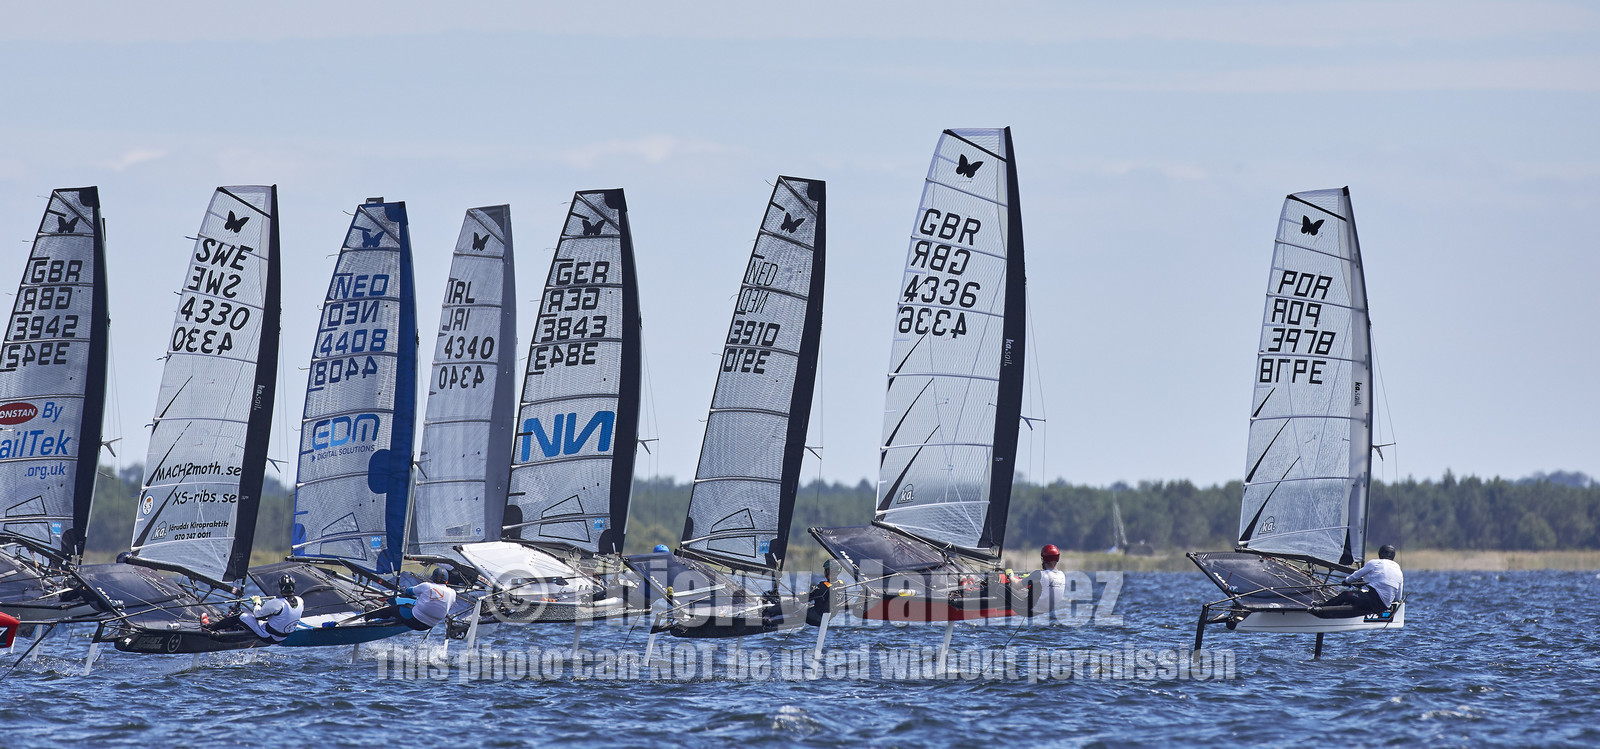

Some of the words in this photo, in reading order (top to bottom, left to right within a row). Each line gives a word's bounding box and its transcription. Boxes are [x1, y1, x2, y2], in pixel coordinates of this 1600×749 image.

[920, 208, 982, 246] GBR
[196, 238, 254, 271] SWE
[31, 260, 82, 283] GBR
[556, 261, 610, 285] GER
[746, 260, 778, 286] NED
[334, 274, 389, 299] NED
[447, 280, 475, 304] IRL
[904, 275, 980, 308] 4336
[1278, 270, 1332, 300] POR
[180, 296, 250, 331] 4330
[13, 315, 78, 340] 3942
[541, 316, 607, 342] 3843
[730, 320, 780, 347] 3910
[320, 329, 388, 355] 4408
[444, 336, 494, 360] 4340
[1268, 328, 1336, 355] 3978
[42, 402, 64, 423] By
[312, 414, 380, 450] EDM
[317, 450, 338, 460] DIGITAL
[339, 444, 375, 456] SOLUTIONS
[24, 462, 66, 480] .org.uk
[156, 462, 242, 482] MACH2moth.se
[172, 492, 238, 506] XS-ribs.se
